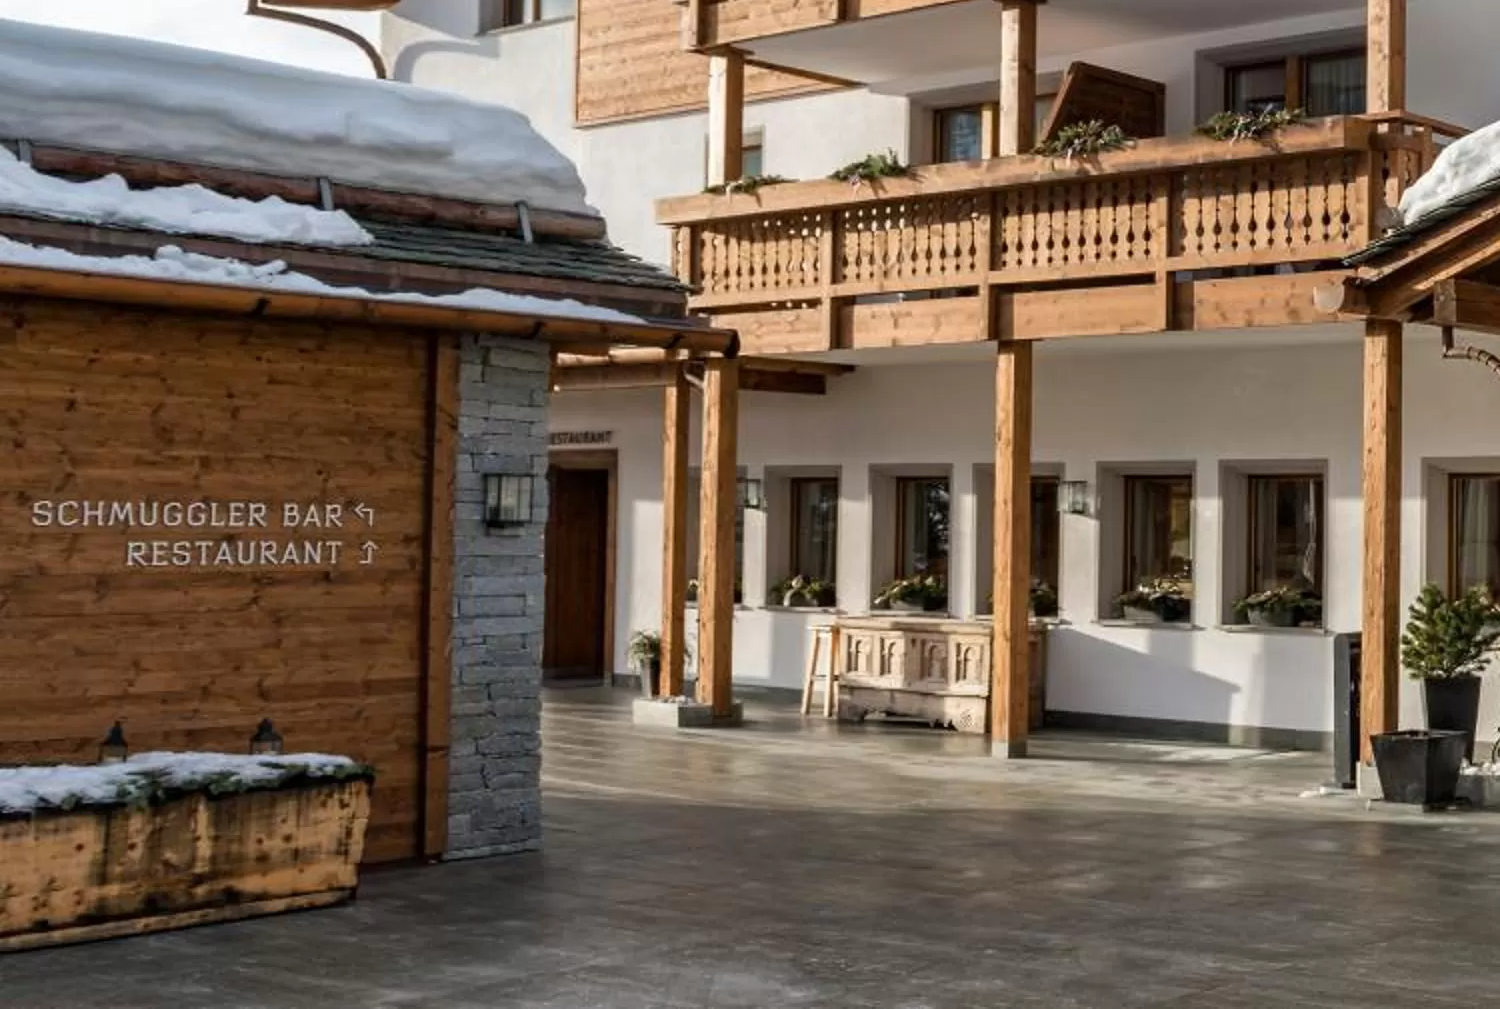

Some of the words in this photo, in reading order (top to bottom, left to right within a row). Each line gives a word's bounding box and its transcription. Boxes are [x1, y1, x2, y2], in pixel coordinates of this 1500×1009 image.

[31, 500, 269, 528] SCHMUGGLER
[282, 502, 344, 529] BAR
[125, 540, 343, 567] RESTAURANT
